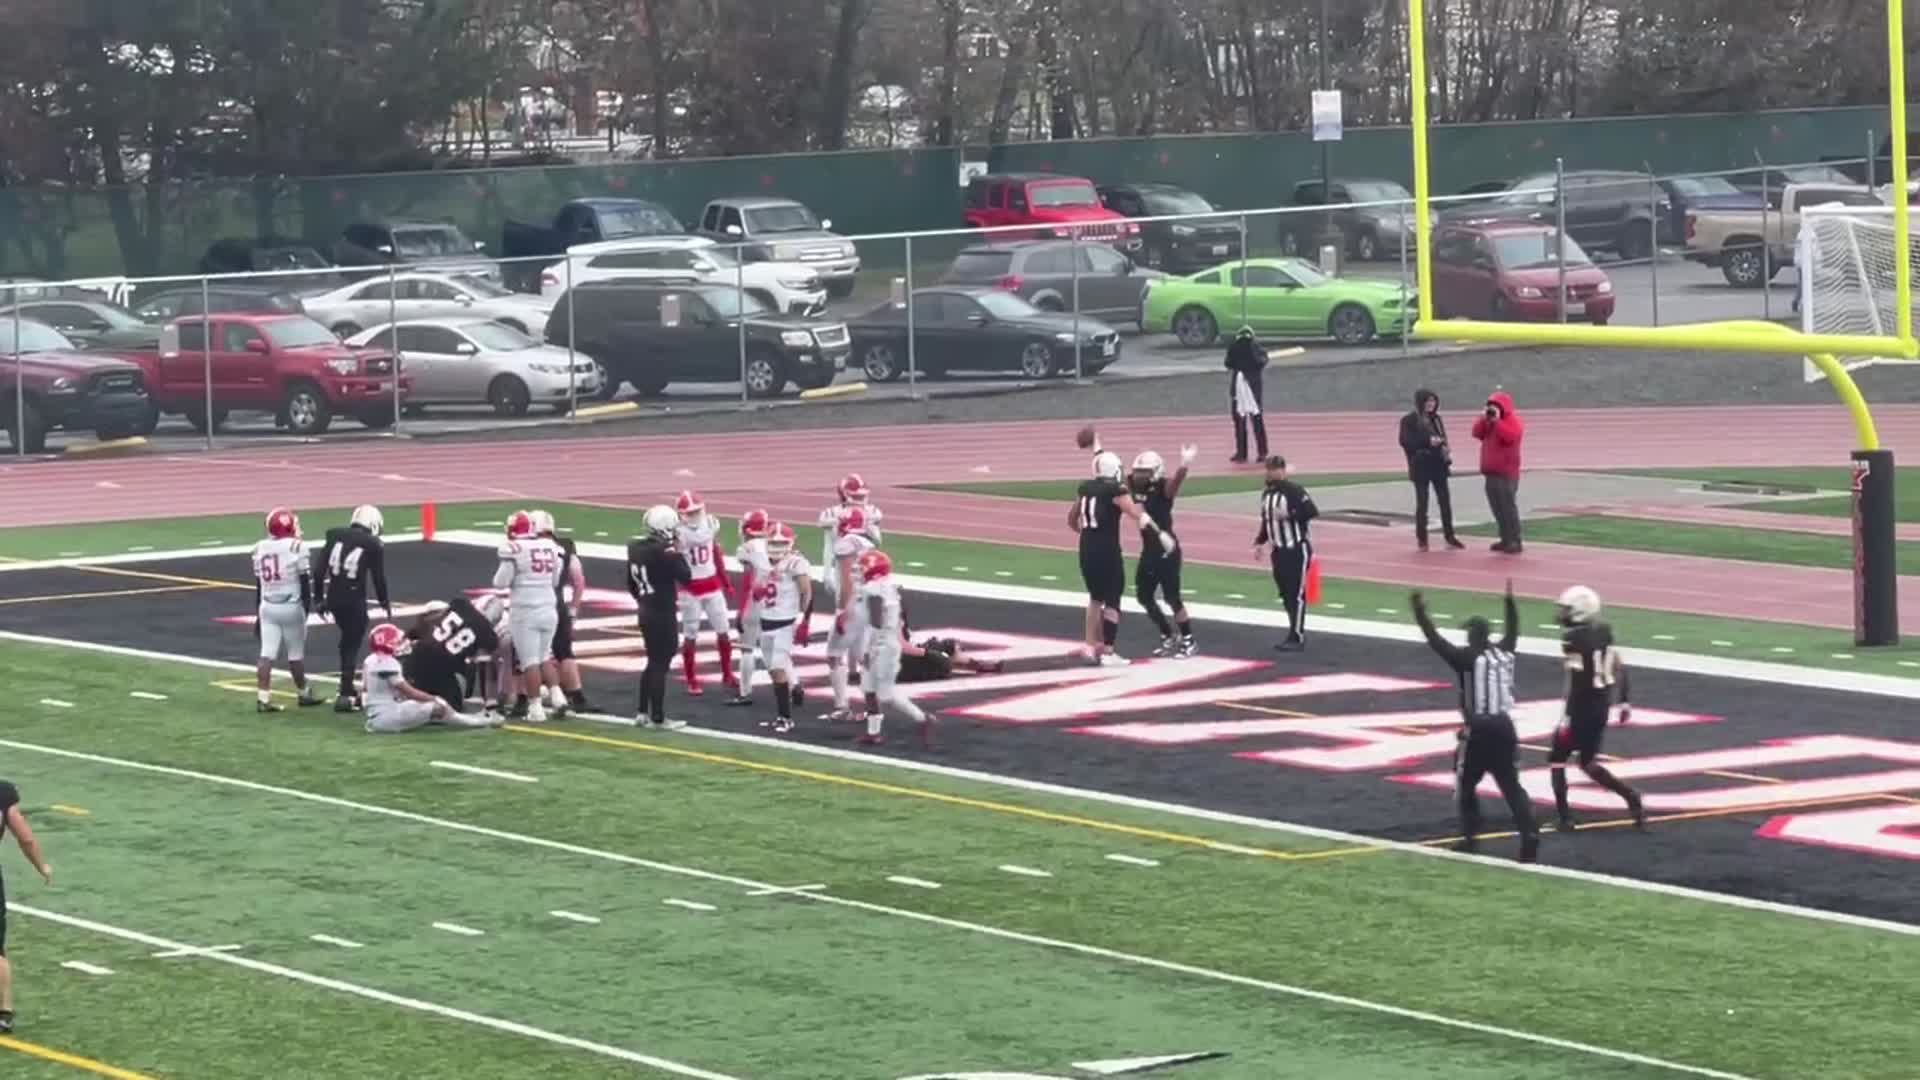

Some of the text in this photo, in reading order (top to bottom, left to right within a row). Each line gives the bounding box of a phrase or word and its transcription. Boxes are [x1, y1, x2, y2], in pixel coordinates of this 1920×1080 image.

[1080, 495, 1098, 529] 11
[260, 554, 281, 583] 61
[328, 541, 364, 579] 44
[688, 545, 709, 567] 10
[432, 611, 476, 654] 58
